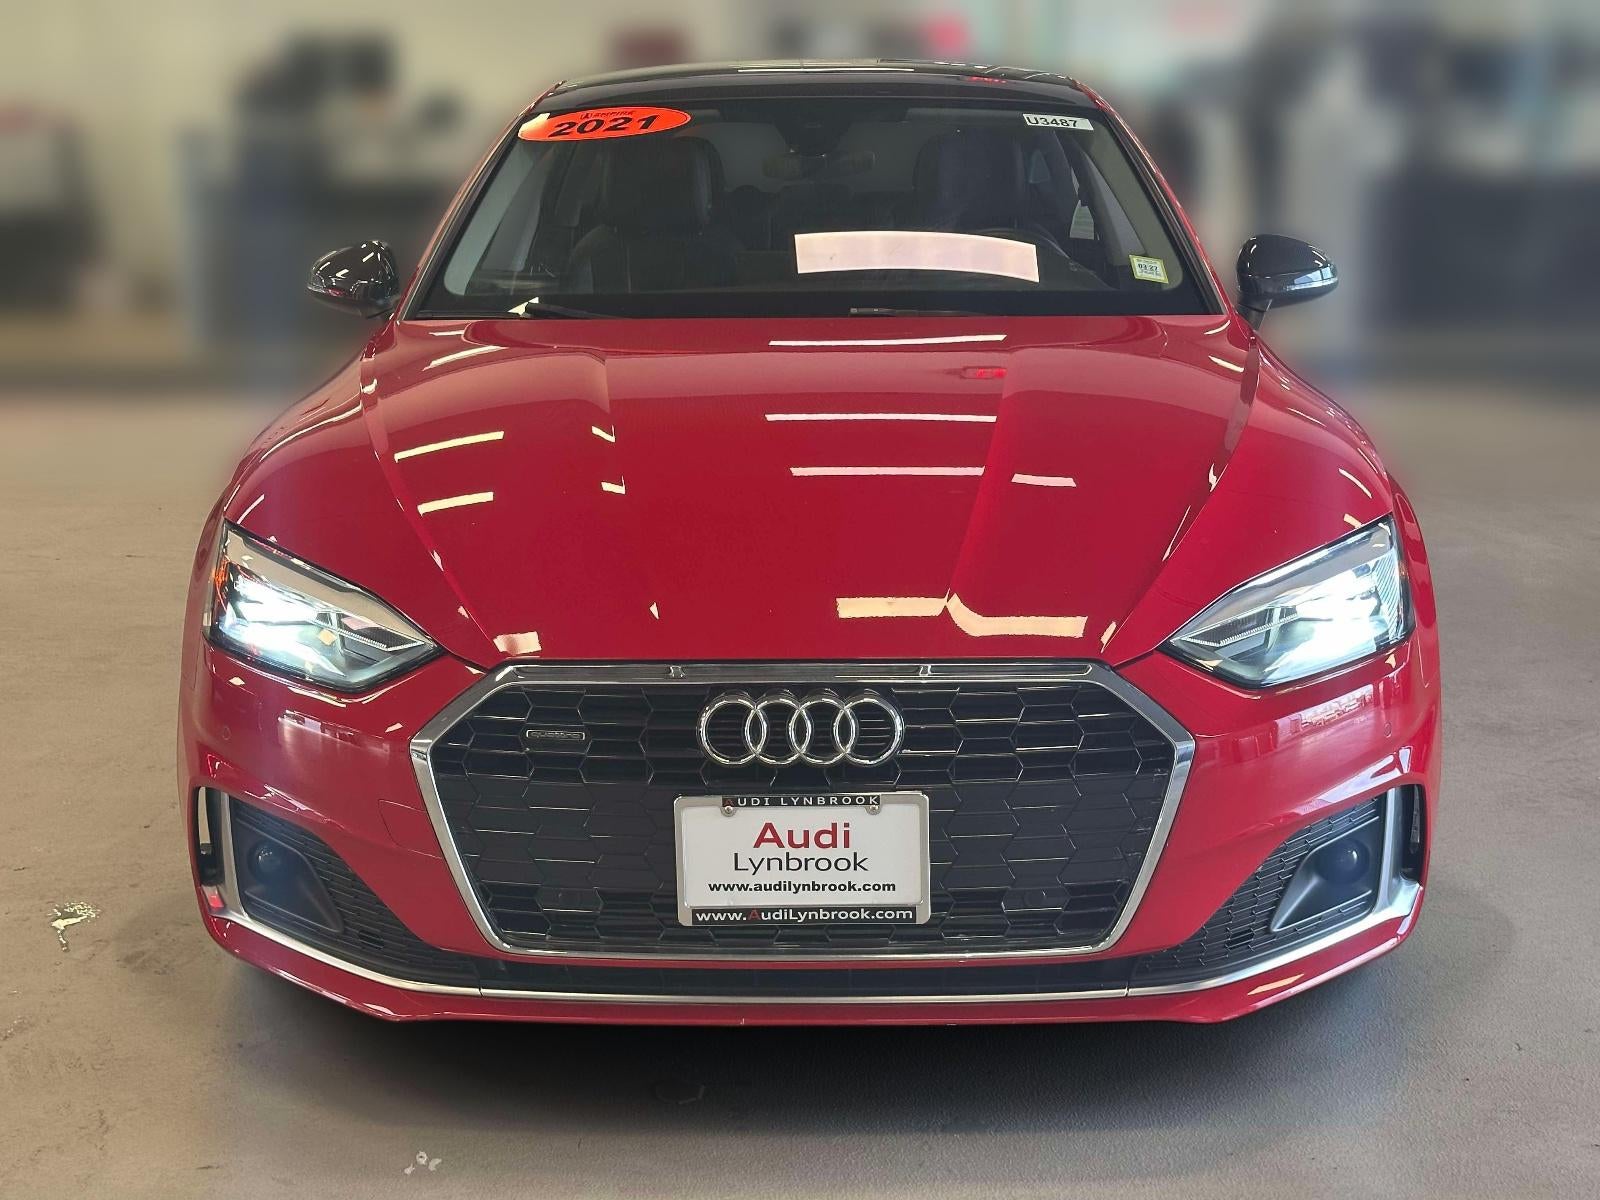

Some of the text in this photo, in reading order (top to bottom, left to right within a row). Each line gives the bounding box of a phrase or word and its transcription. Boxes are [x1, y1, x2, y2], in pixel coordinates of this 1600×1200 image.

[547, 114, 659, 138] 2021
[1026, 116, 1078, 128] U3487
[723, 795, 880, 806] AUDI LYNBROOK
[753, 822, 850, 849] Audi
[734, 852, 869, 875] Lynbrook
[708, 881, 896, 894] www.audilynbrook.com
[696, 908, 913, 924] www.AudiLynbrook.com
